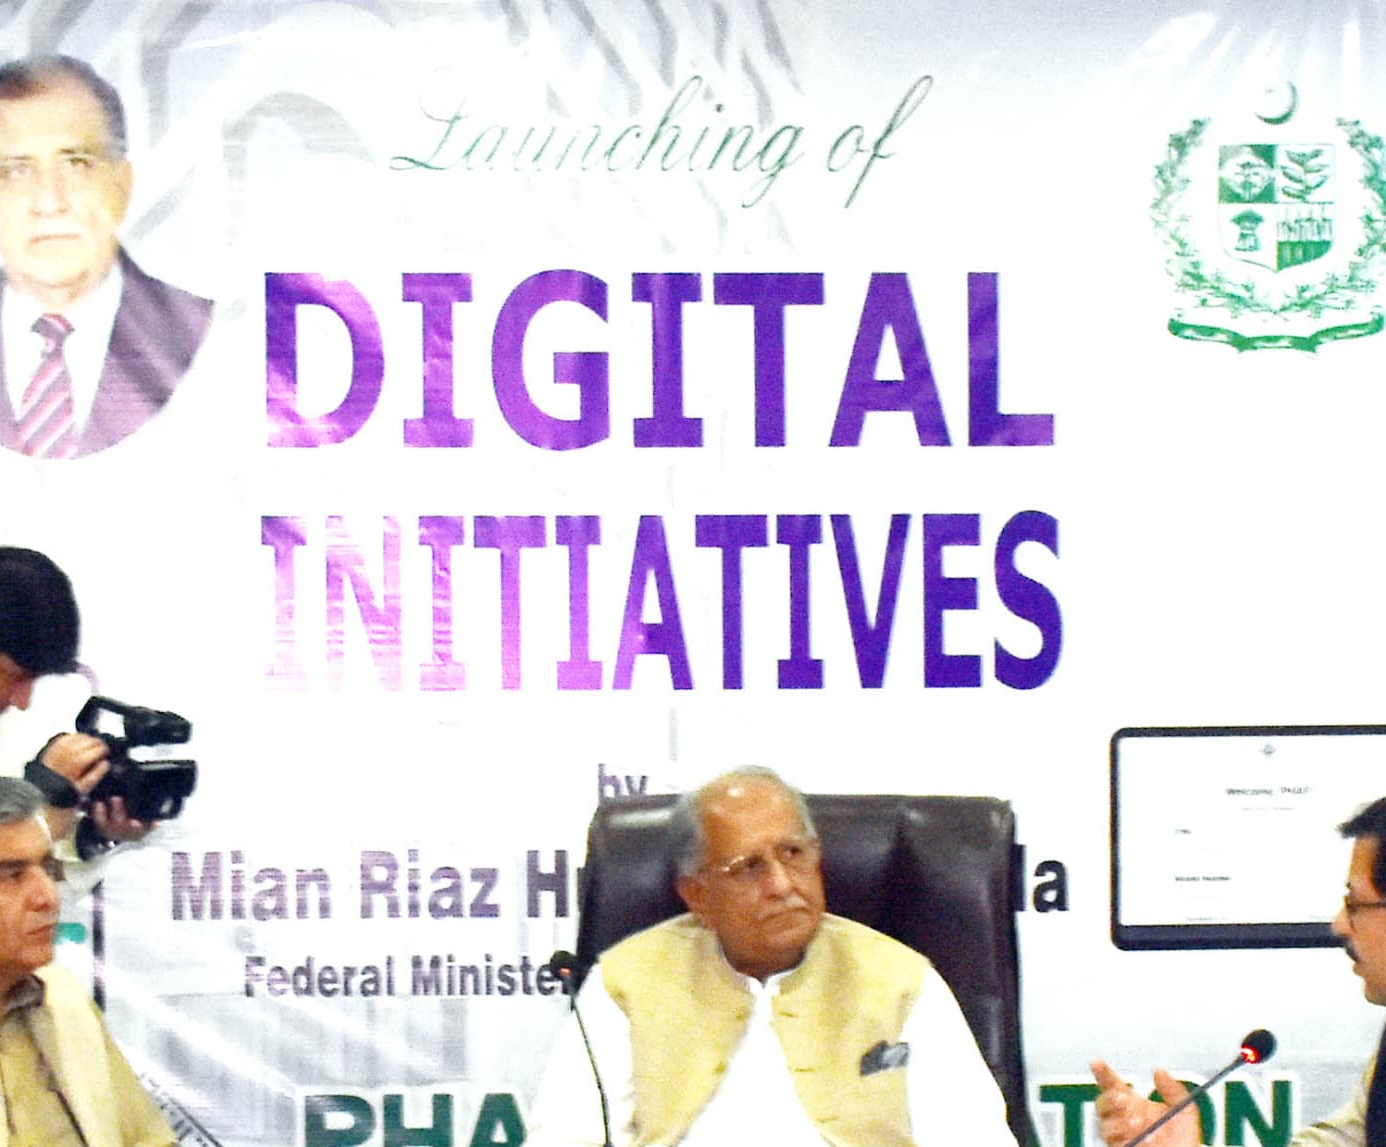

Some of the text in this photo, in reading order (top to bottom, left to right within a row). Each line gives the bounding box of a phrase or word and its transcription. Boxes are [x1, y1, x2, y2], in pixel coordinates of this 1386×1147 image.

[388, 74, 934, 209] Launching of
[264, 269, 1055, 451] DIGITAL
[260, 509, 1065, 693] INITIATIVES
[170, 849, 334, 922] Mian
[359, 848, 502, 921] Riaz
[244, 954, 397, 998] Federal
